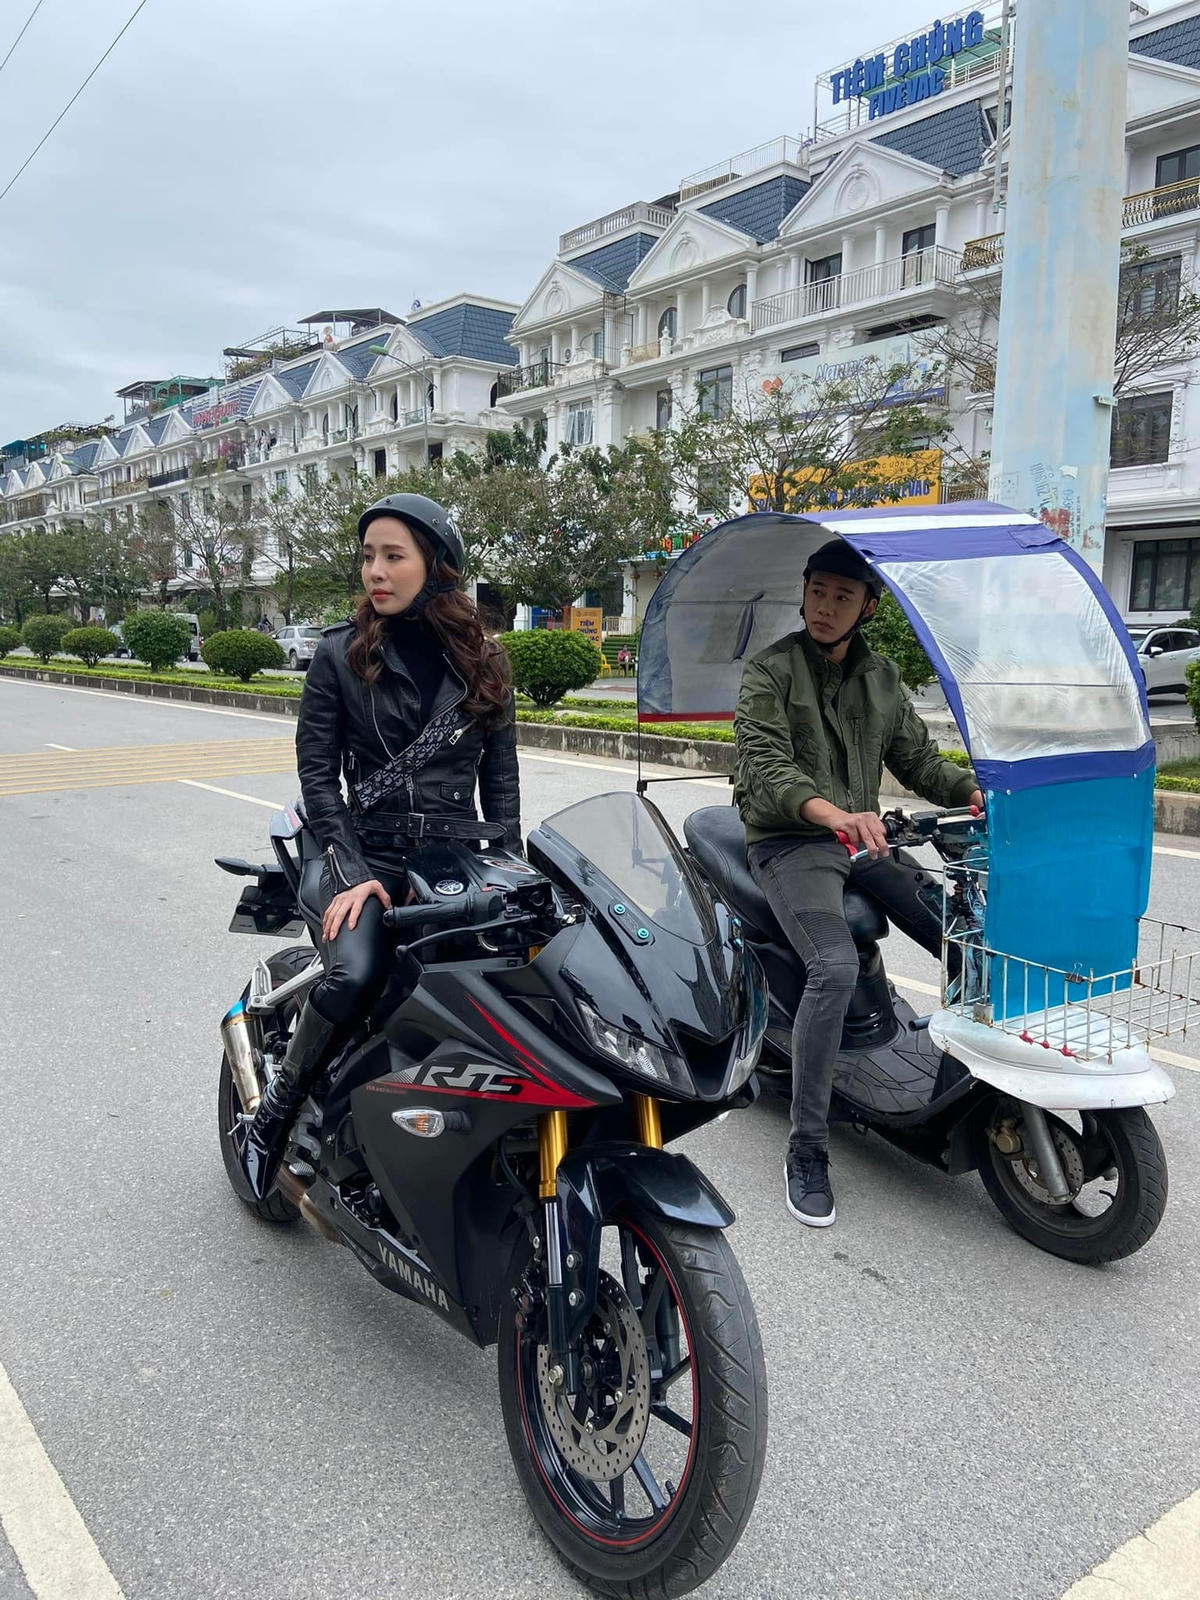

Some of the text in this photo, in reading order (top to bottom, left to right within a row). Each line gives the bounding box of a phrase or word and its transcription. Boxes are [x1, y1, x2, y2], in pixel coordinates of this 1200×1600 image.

[830, 10, 984, 105] TIÊM CHỦNG
[868, 68, 946, 121] FIVEVAC
[376, 1241, 450, 1312] YAMAHA
